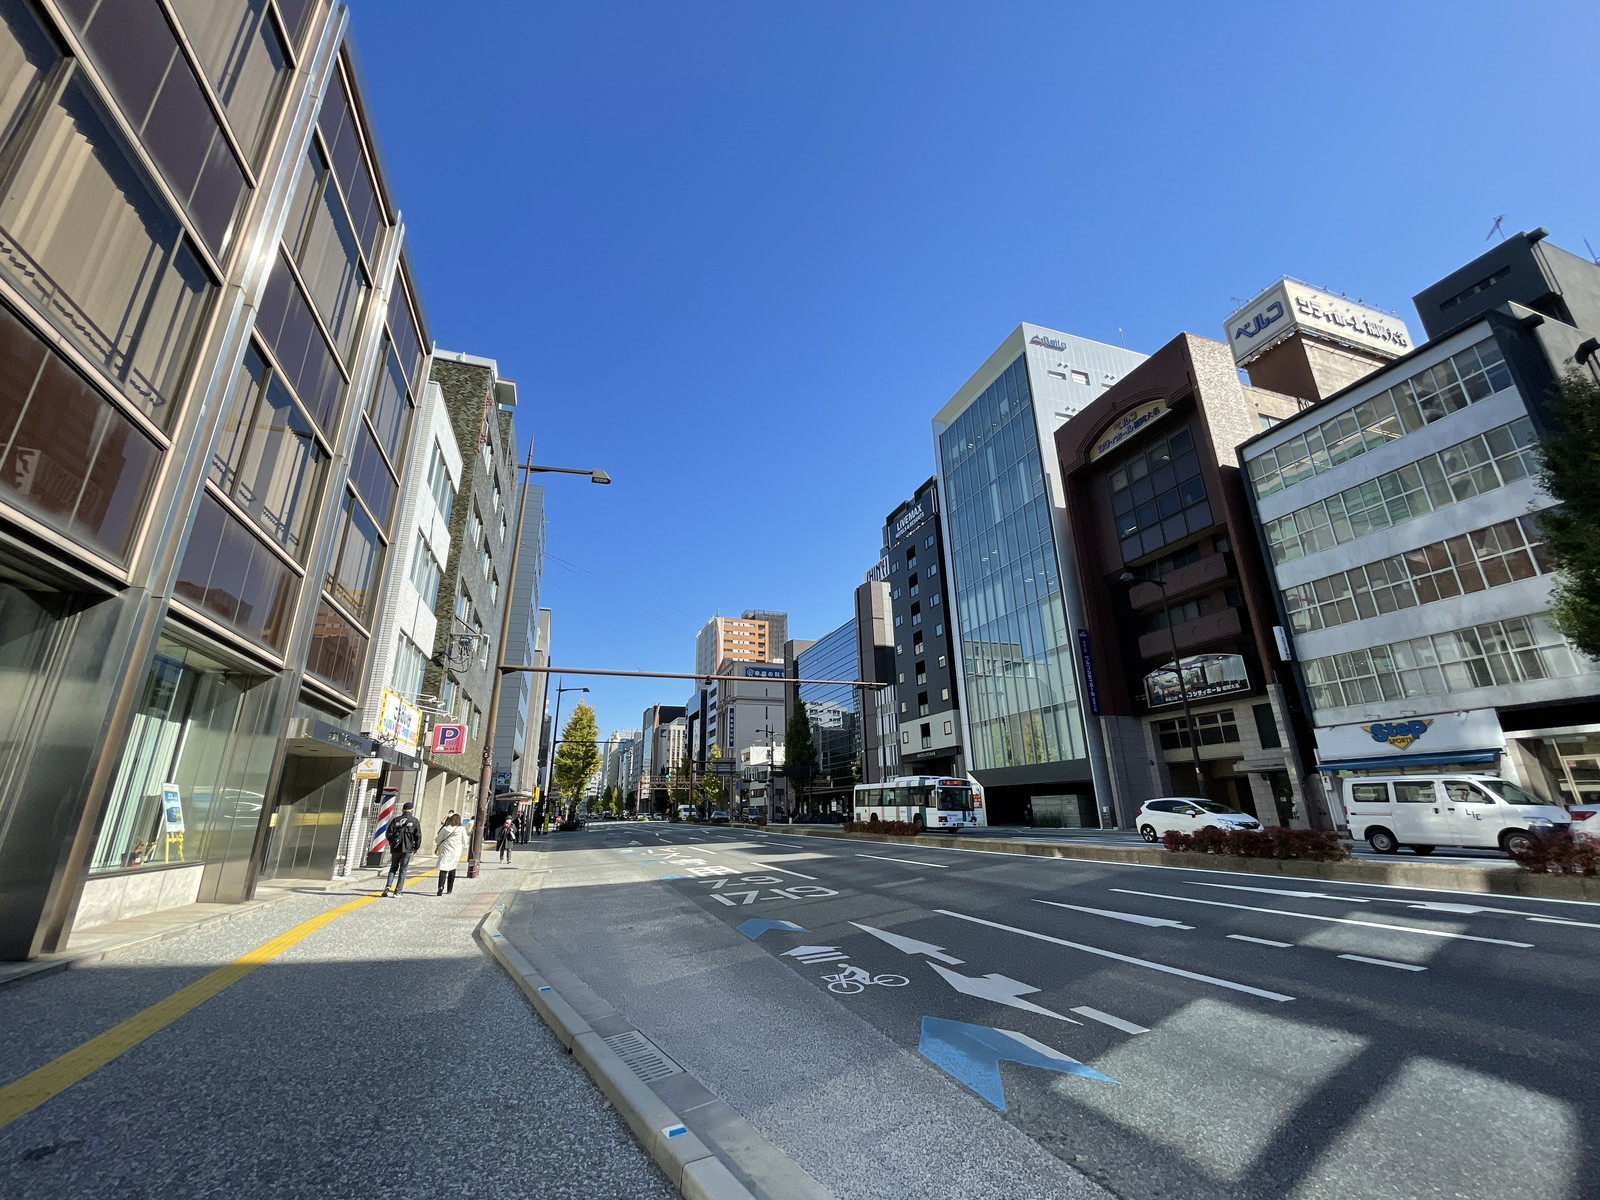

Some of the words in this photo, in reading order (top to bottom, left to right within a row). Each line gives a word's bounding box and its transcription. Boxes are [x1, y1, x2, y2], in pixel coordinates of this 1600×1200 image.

[1234, 301, 1284, 340] ベルコ
[1113, 411, 1138, 431] ベルコ
[896, 503, 922, 531] LIVEMAX
[439, 727, 460, 746] P
[1370, 720, 1428, 743] Step
[1389, 736, 1413, 745] SPORTS
[698, 875, 784, 889] 7-9
[709, 885, 840, 907] 17-19
